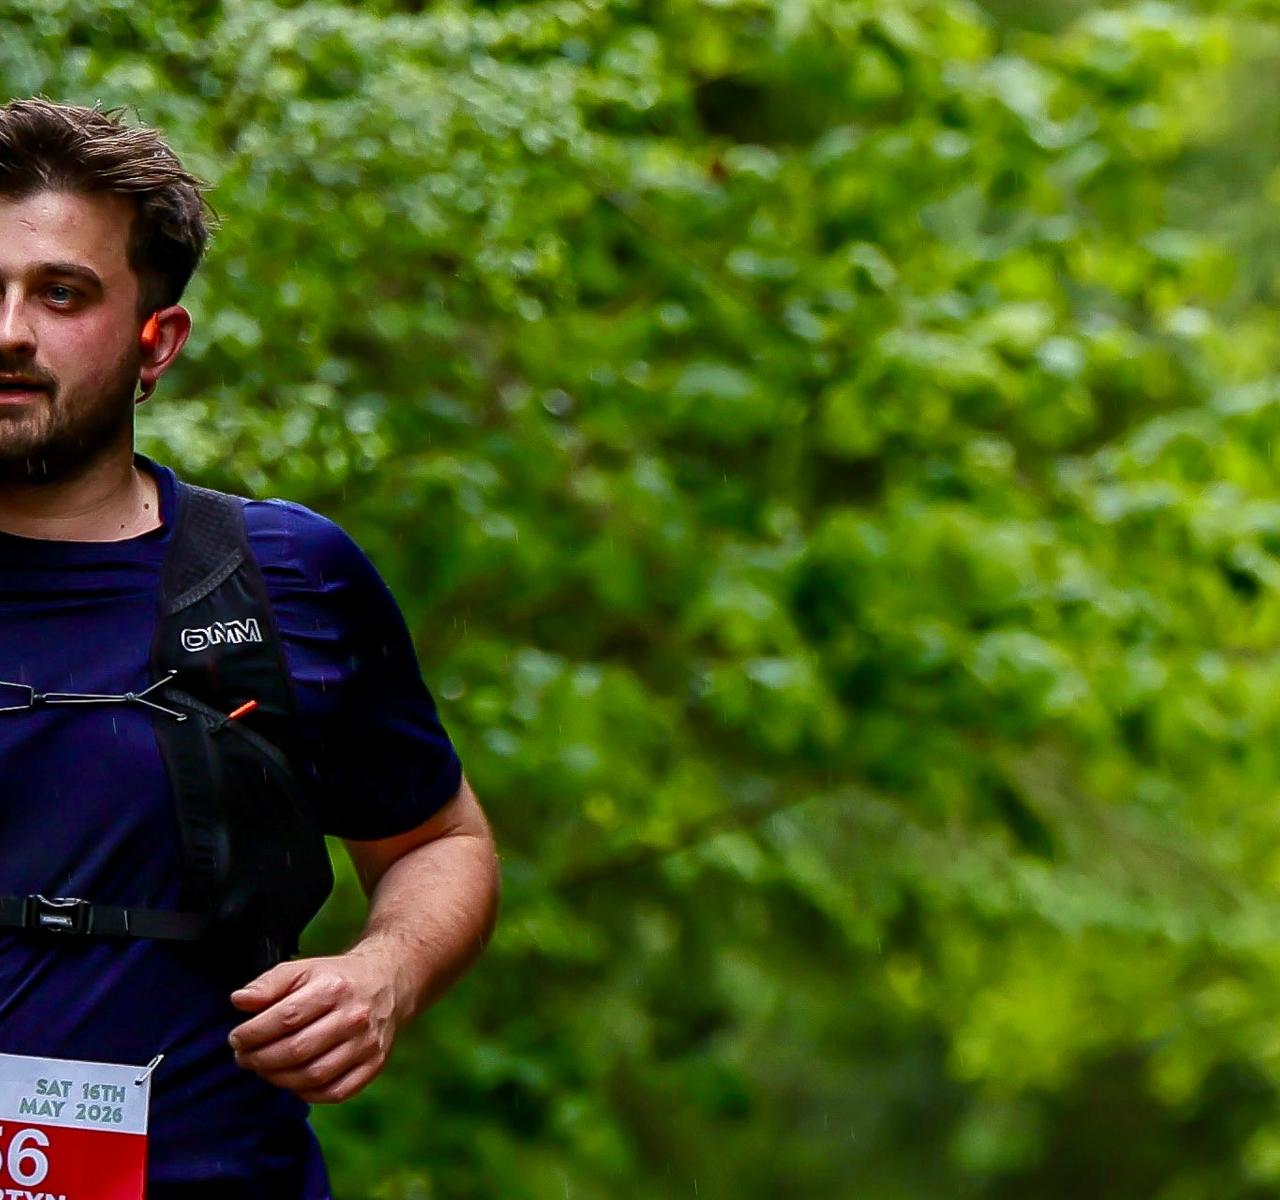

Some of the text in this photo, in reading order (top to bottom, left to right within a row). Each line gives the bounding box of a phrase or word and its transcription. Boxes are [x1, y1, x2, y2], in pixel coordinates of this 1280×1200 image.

[180, 618, 262, 652] OMM
[35, 1078, 126, 1102] SAT 16TH
[19, 1097, 123, 1123] MAY 2026
